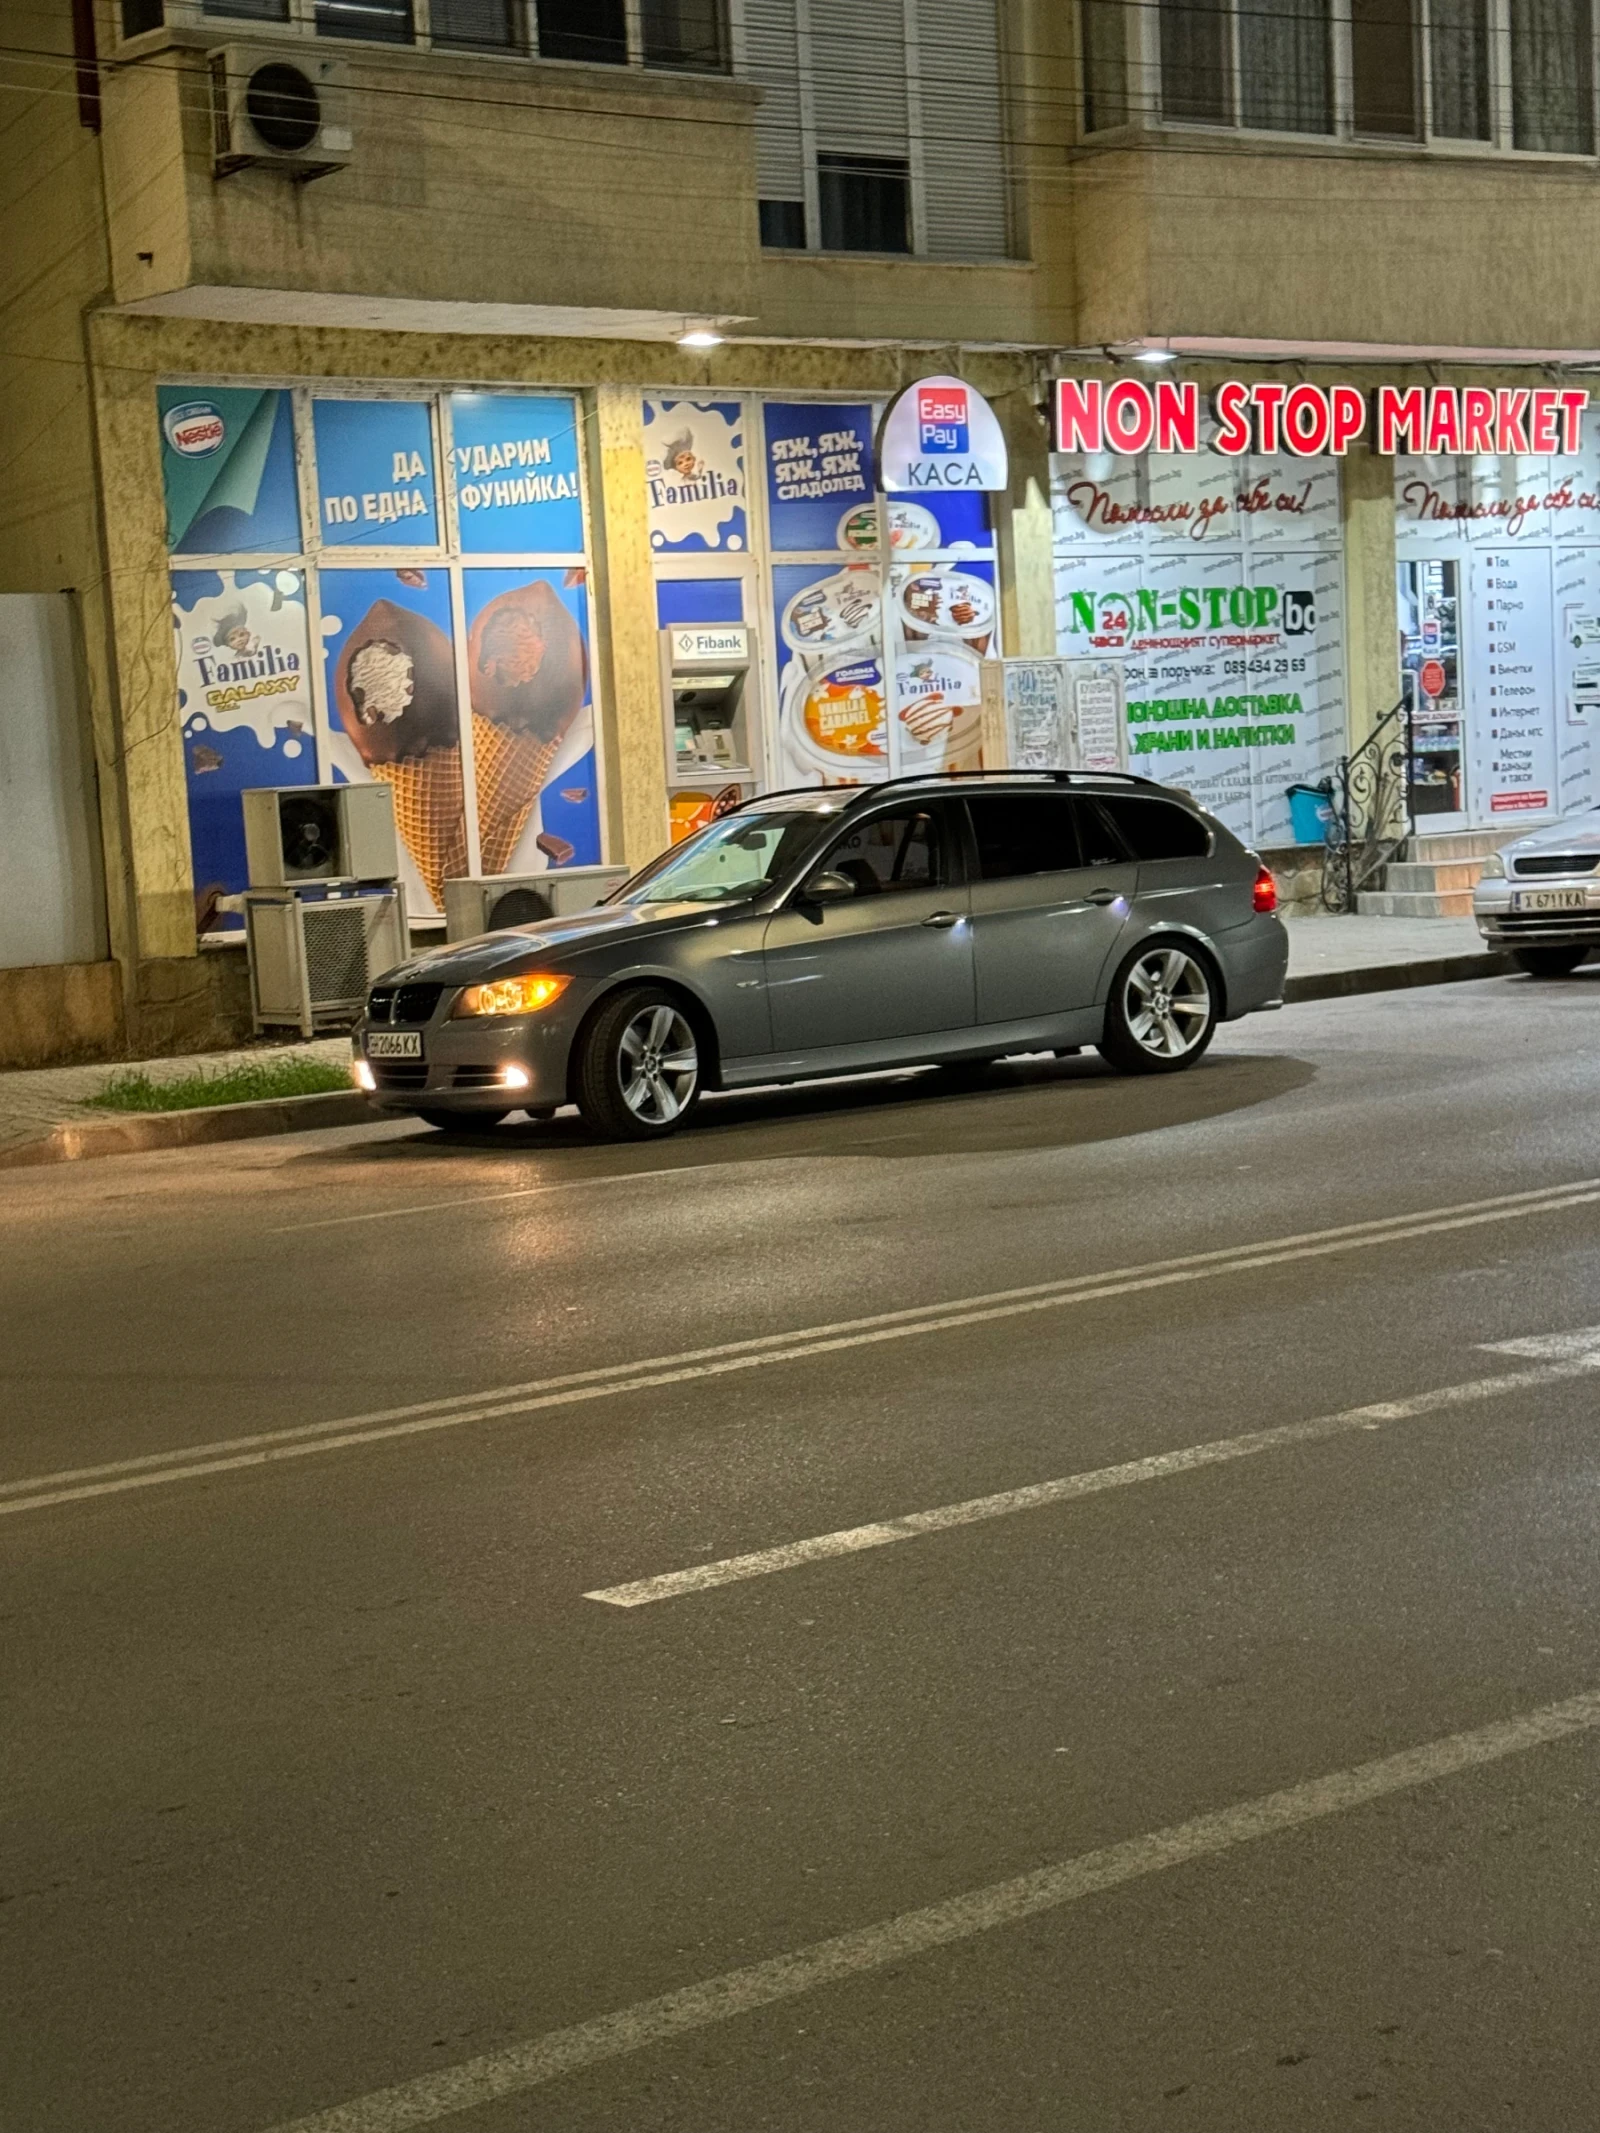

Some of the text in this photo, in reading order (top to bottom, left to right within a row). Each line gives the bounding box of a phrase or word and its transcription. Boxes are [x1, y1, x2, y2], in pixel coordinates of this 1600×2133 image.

[920, 398, 966, 425] Easy
[1056, 379, 1590, 456] NON STOP MARKET
[921, 424, 957, 450] Pay
[392, 437, 552, 484] ДА УДАРИМ
[822, 452, 861, 476] ЯЖ
[907, 462, 984, 486] КАСА
[324, 471, 579, 525] ПО ЕДНА ФУНИЙКА!
[646, 470, 738, 509] Familia
[777, 474, 866, 500] СЛАДОЛЕД
[1102, 611, 1128, 631] 24
[697, 635, 742, 649] Fibank
[193, 645, 300, 688] Familia
[206, 675, 300, 706] GALAXY
